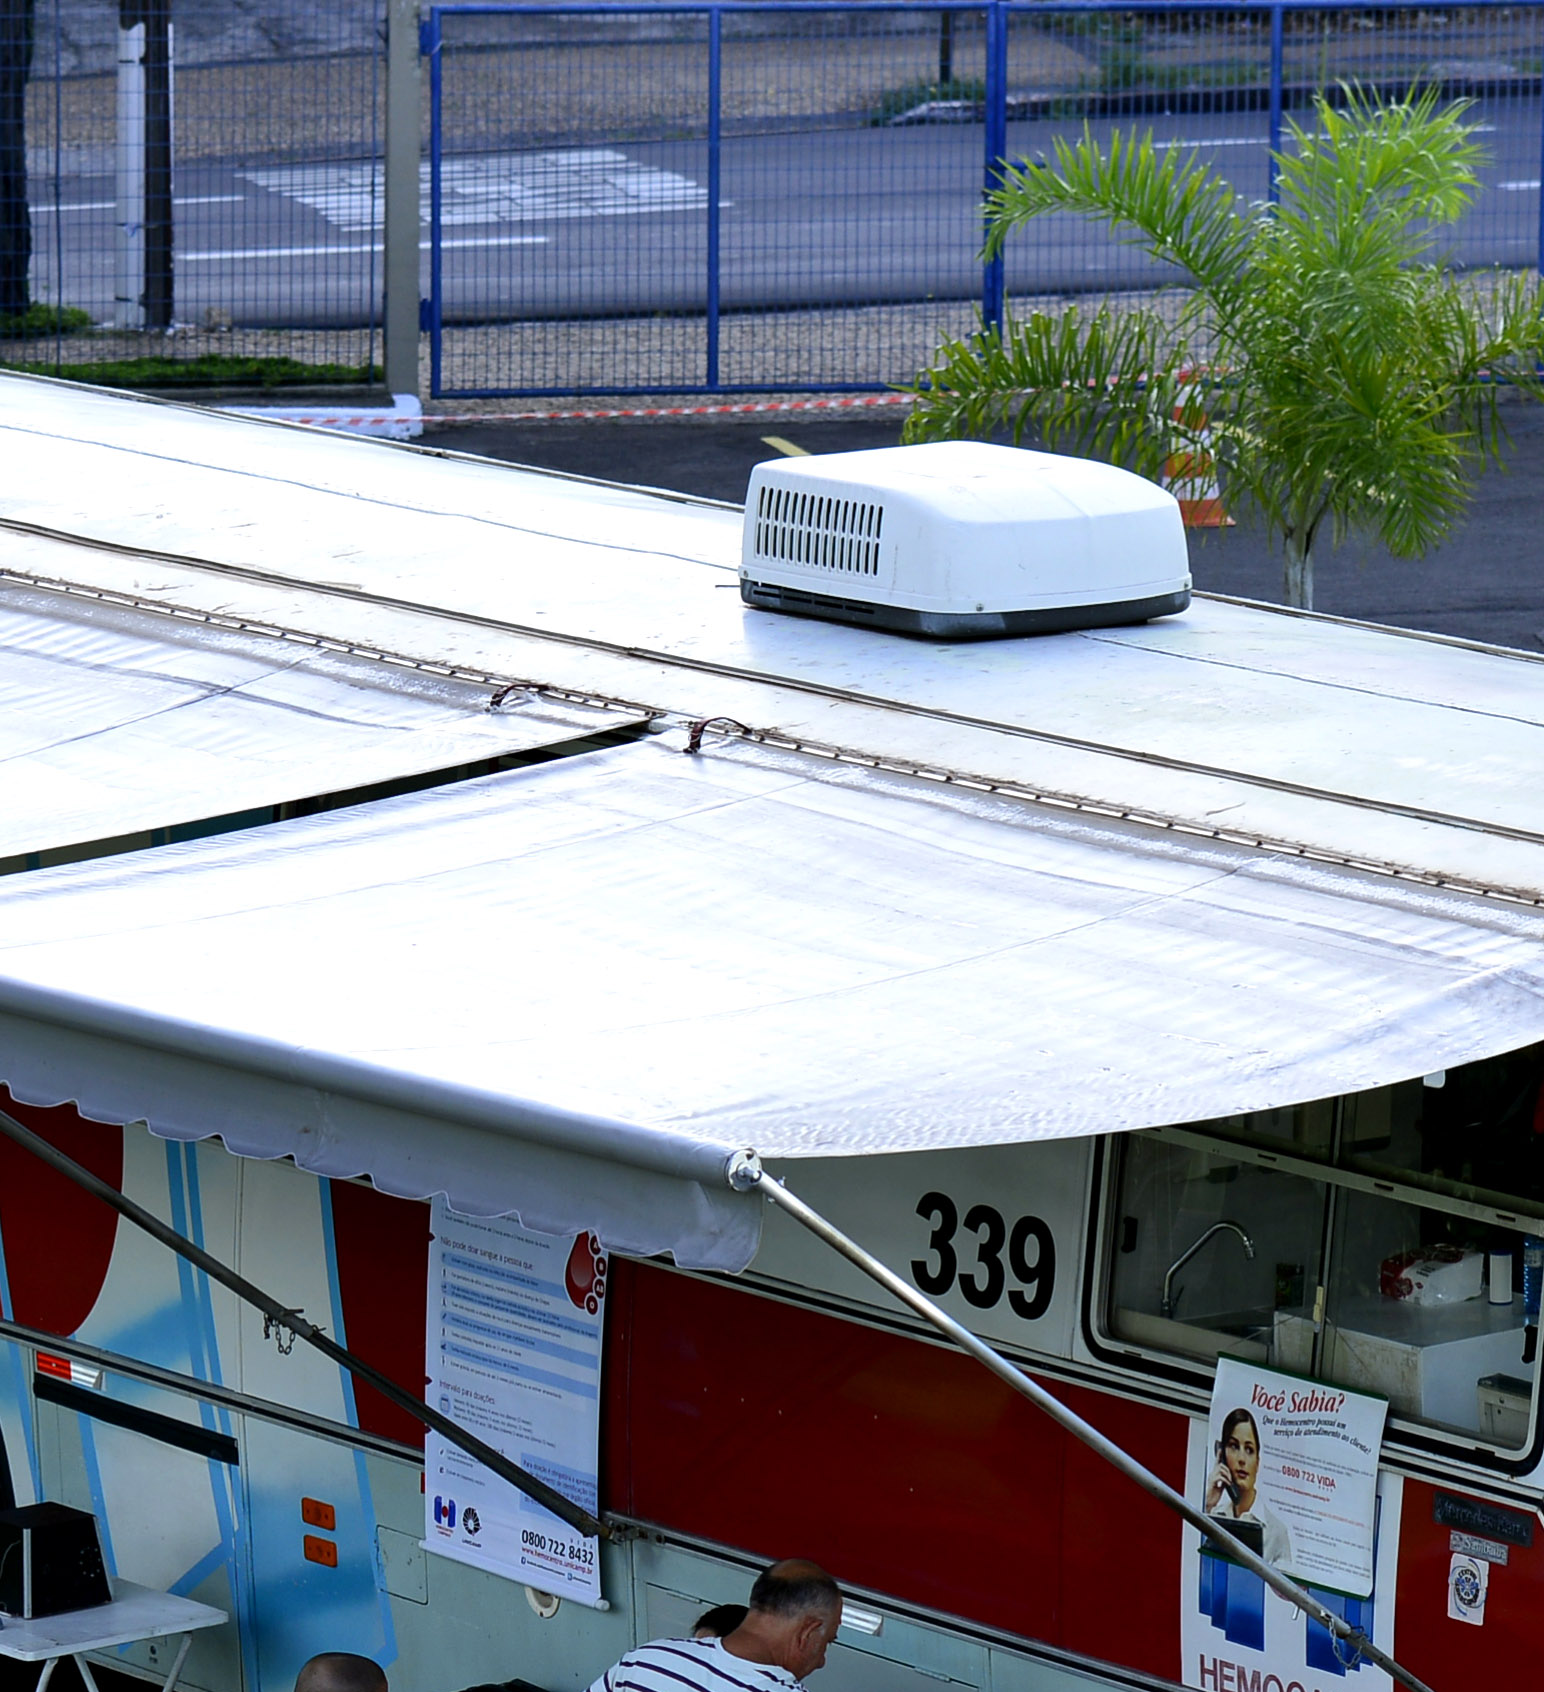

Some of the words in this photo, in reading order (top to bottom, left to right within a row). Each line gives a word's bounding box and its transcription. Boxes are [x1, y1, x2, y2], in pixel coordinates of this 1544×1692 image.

[910, 1191, 1056, 1320] 339
[1251, 1383, 1286, 1412] Você
[1288, 1389, 1345, 1413] Sabia?
[1262, 1415, 1274, 1426] Que
[1280, 1417, 1316, 1427] Hemocentro
[1316, 1418, 1336, 1429] possui
[1337, 1421, 1347, 1430] um
[1273, 1428, 1294, 1438] serviço
[1294, 1427, 1302, 1437] de
[1303, 1427, 1341, 1440] atendimento
[1341, 1434, 1350, 1443] ao
[1282, 1465, 1300, 1479] 0800
[1302, 1470, 1315, 1483] 722
[1317, 1474, 1336, 1488] VIDA
[521, 1529, 546, 1550] 0800
[548, 1537, 566, 1557] 722
[568, 1545, 594, 1566] 8432
